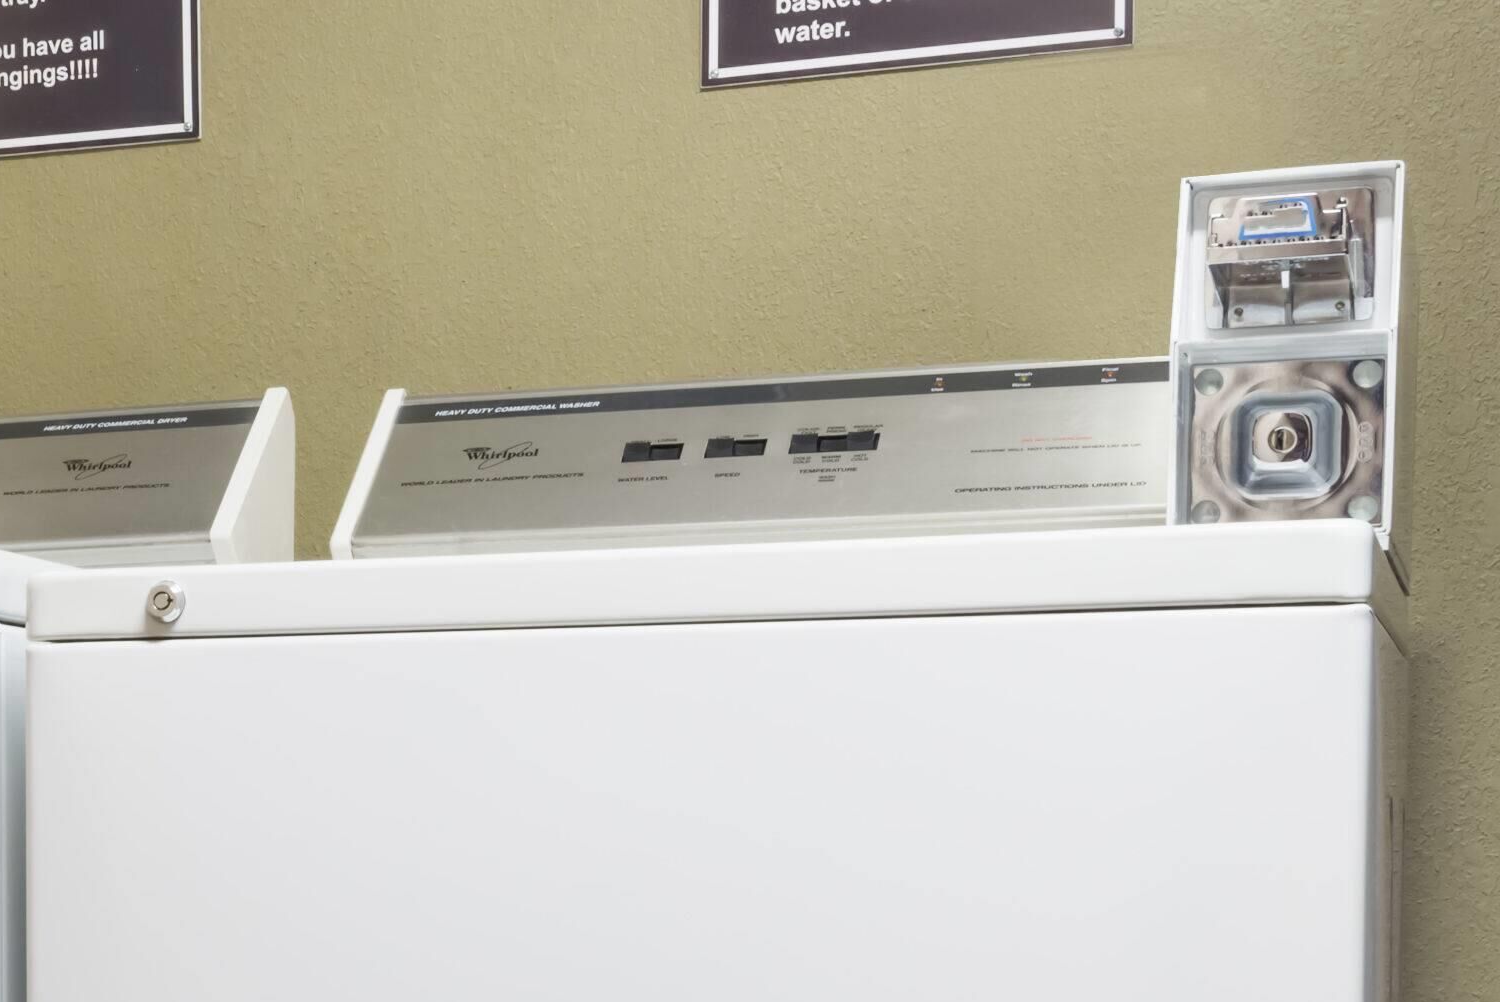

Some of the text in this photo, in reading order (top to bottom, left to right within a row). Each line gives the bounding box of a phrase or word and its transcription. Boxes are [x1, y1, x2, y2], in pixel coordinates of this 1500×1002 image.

[774, 19, 851, 44] water.
[22, 37, 74, 57] have
[79, 30, 105, 52] all
[435, 400, 600, 417] HEAVY DUTY COMMERCIAL WASHER
[43, 416, 188, 432] HEAVY DUTY COMMERCIAL DRYER
[463, 444, 539, 465] Whirlpool
[63, 457, 132, 476] Whirlpool
[532, 472, 584, 480] PRODUCTS
[954, 486, 1011, 494] OPERATING
[1014, 483, 1089, 491] INSTRUCTIONS
